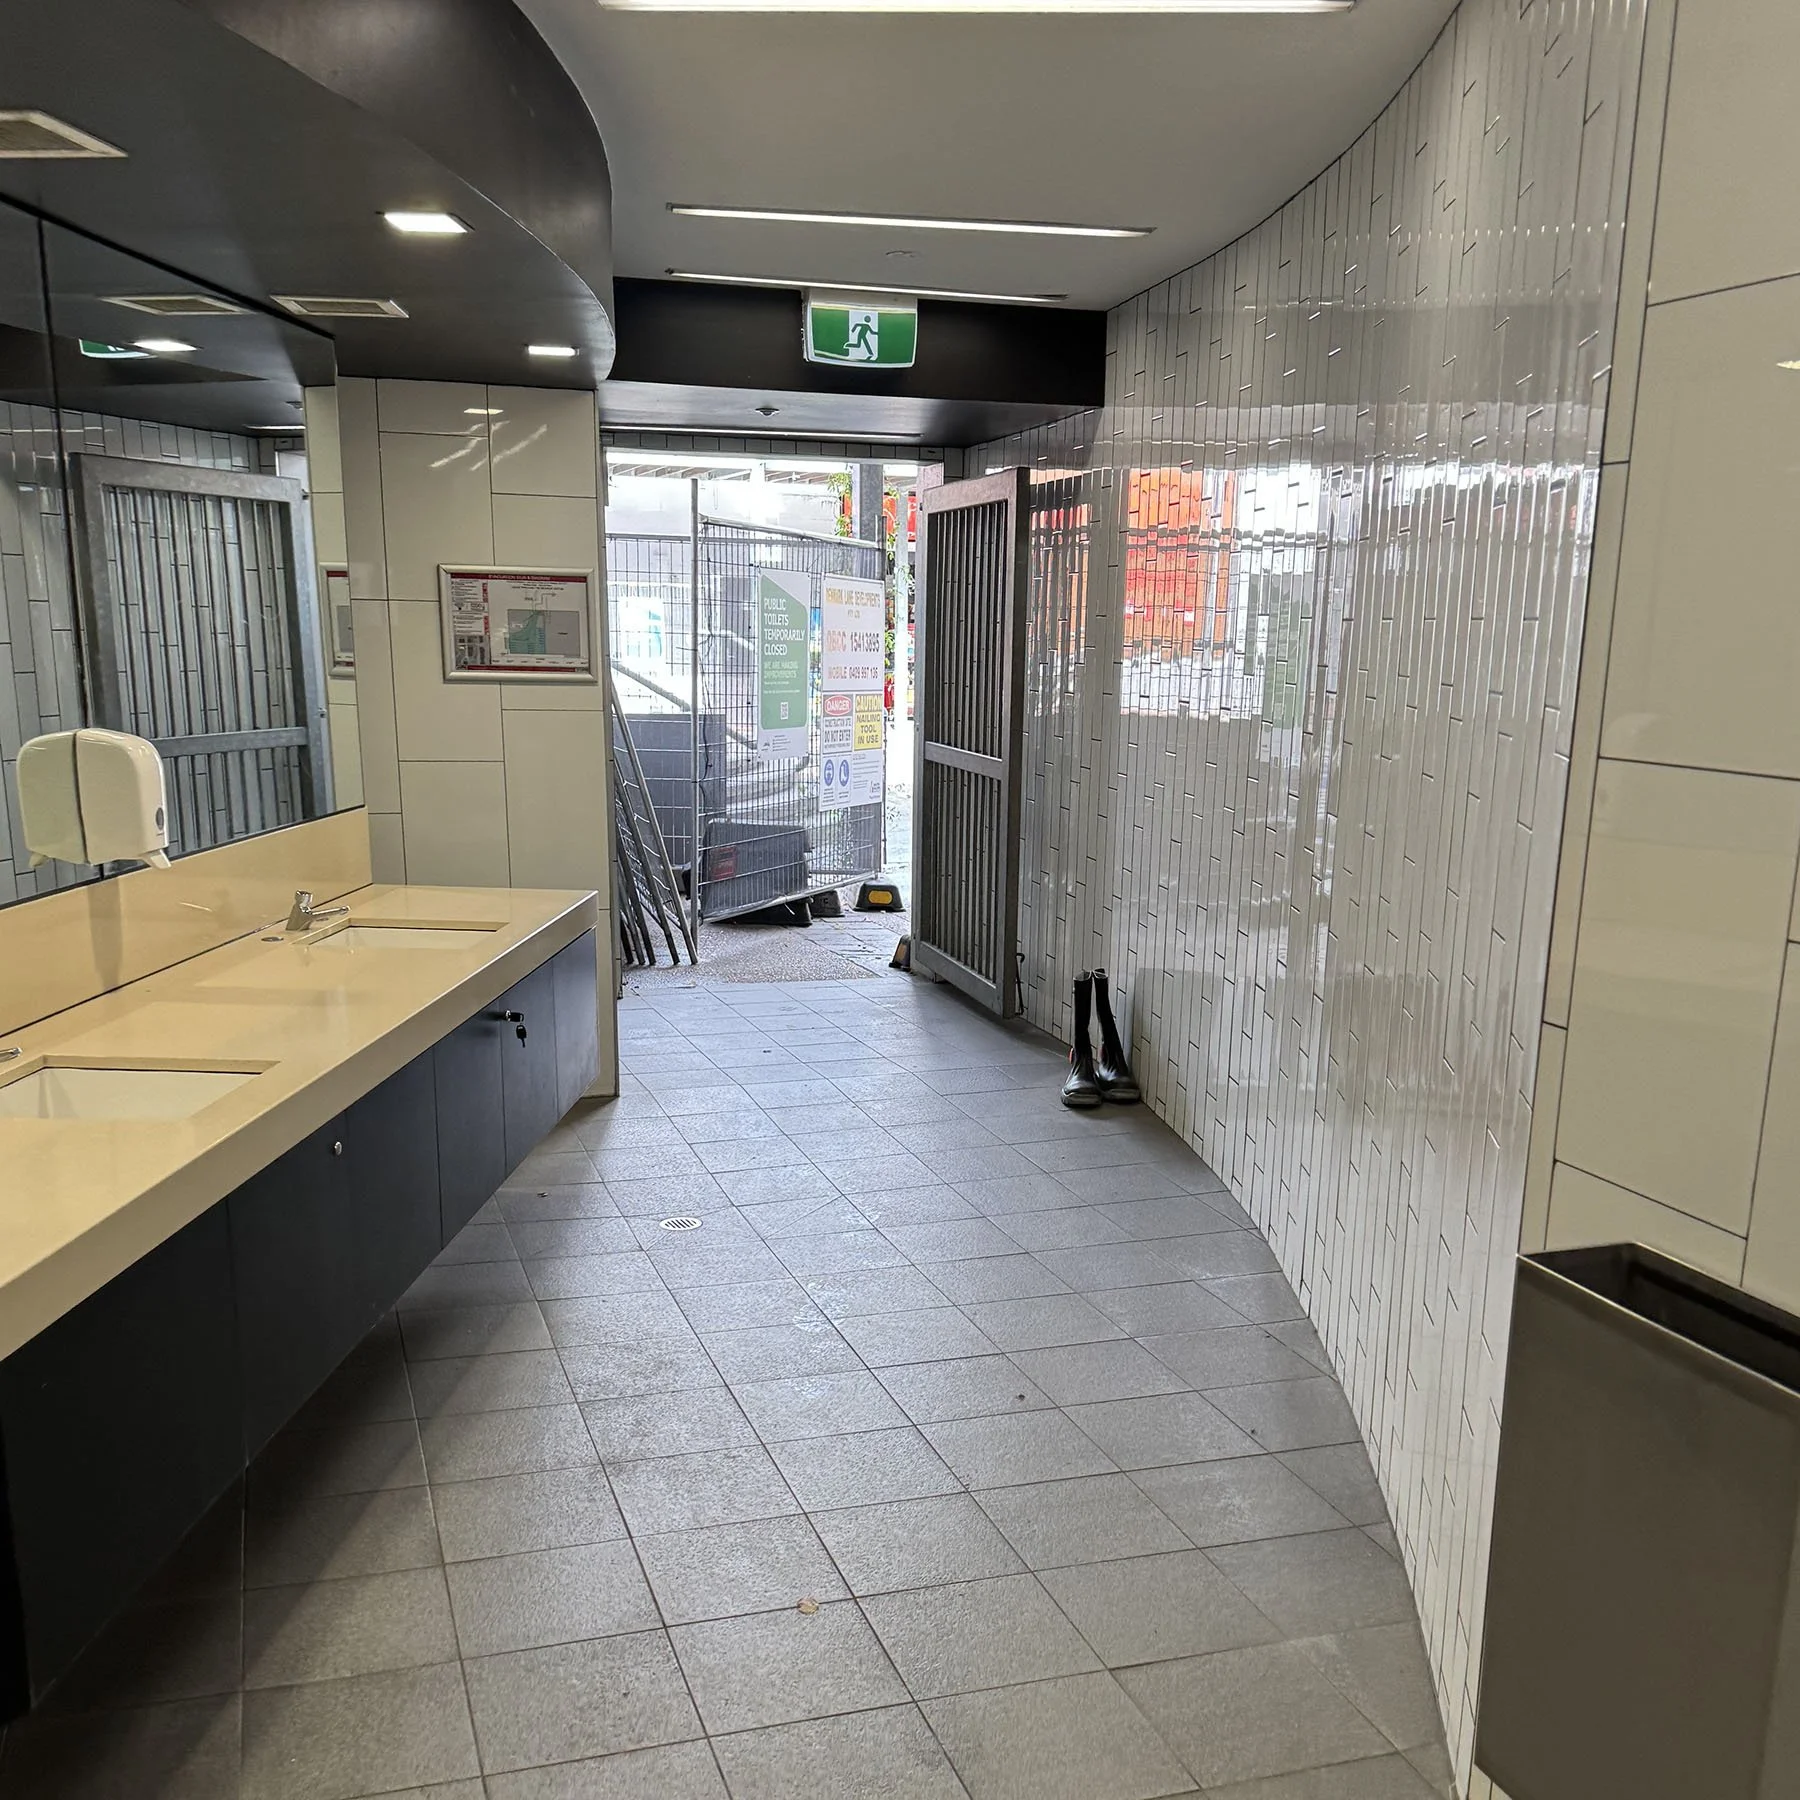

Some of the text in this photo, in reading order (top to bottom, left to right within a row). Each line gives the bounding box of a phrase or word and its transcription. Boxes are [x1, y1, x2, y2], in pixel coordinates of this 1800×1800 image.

[764, 598, 787, 610] PUBLIC
[764, 614, 789, 626] TOILETS
[764, 629, 806, 641] TEMPORARILY
[764, 644, 787, 656] CLOSED
[826, 700, 850, 712] DANGER
[856, 695, 882, 712] CAUTION
[857, 713, 880, 723] NAILING
[860, 725, 877, 733] TOOL
[857, 734, 879, 744] IN USE
